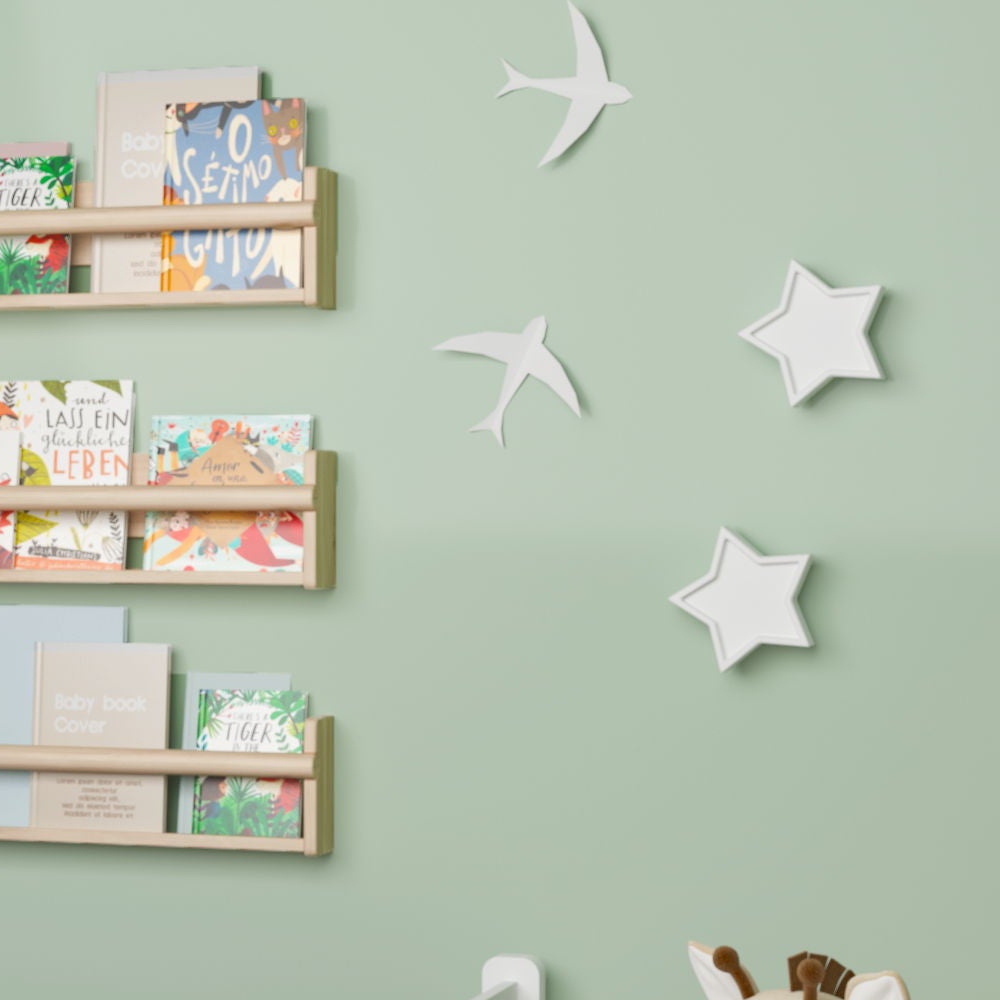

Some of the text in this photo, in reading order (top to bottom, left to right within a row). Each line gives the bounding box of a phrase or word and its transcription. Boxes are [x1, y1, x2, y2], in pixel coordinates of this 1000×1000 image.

[228, 114, 252, 163] O
[46, 407, 129, 431] LASS EIN
[53, 449, 130, 480] LEBEN
[55, 693, 147, 715] Baby book
[55, 715, 106, 733] Cover
[224, 721, 272, 743] TIGER
